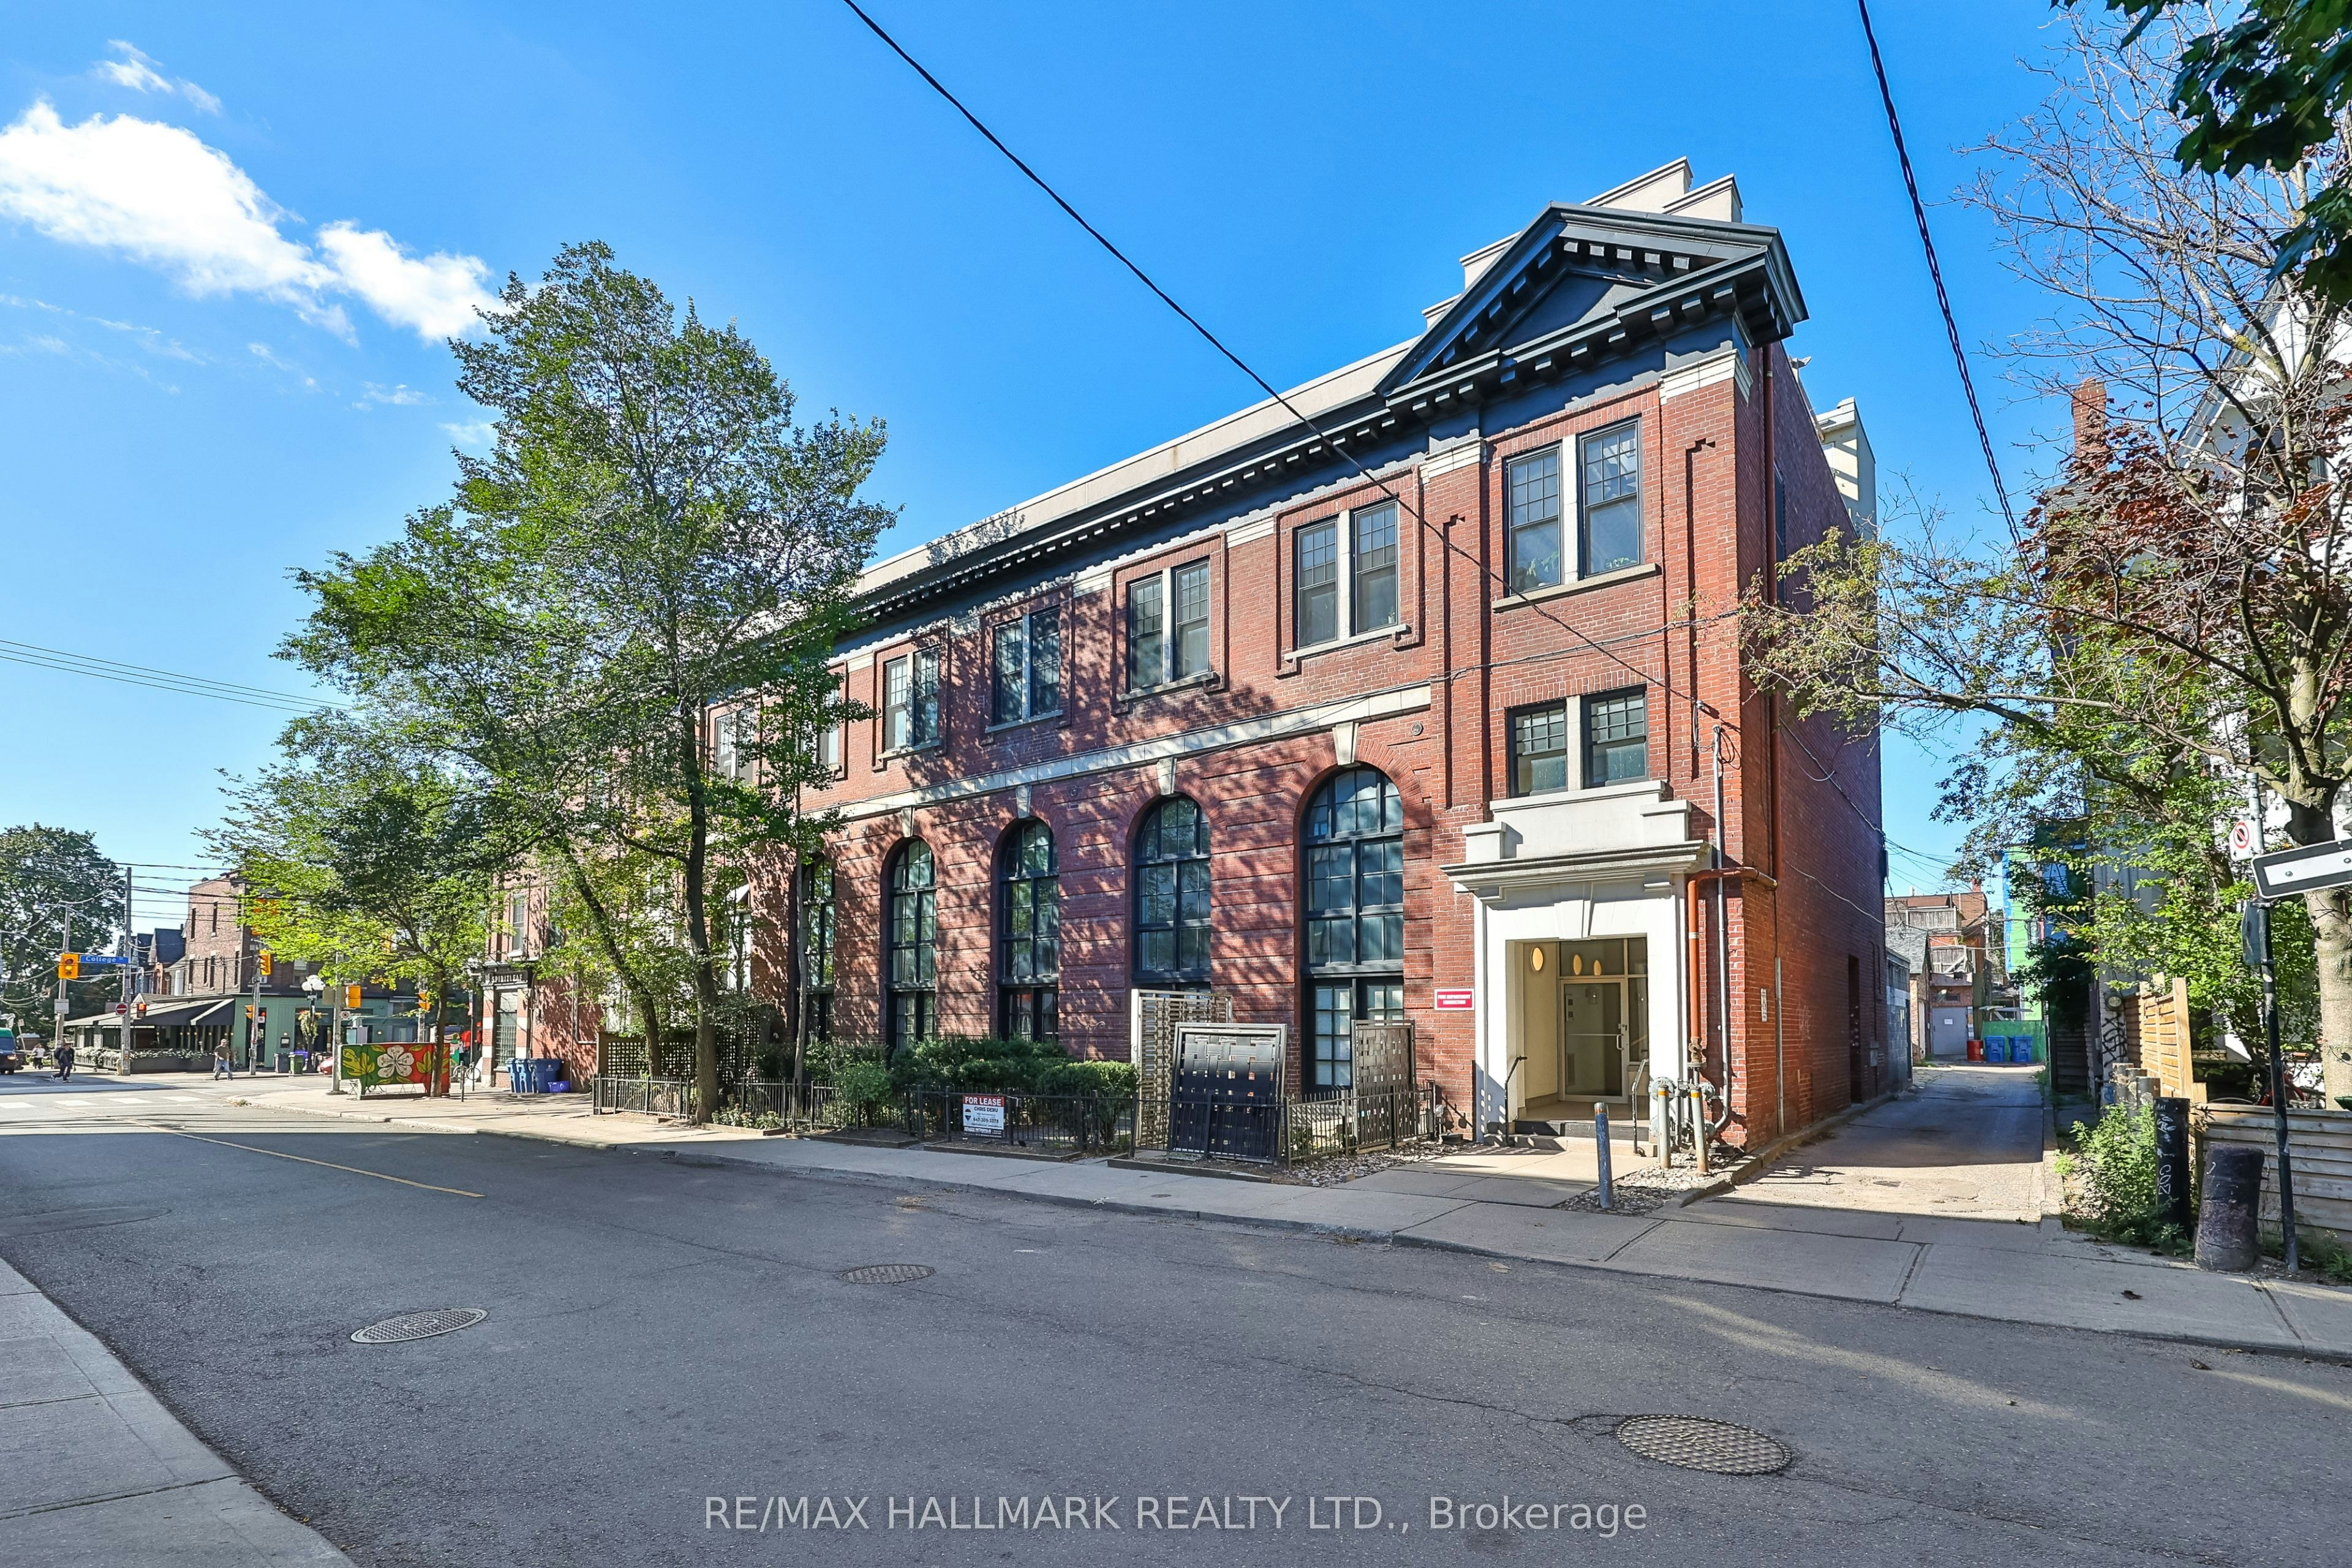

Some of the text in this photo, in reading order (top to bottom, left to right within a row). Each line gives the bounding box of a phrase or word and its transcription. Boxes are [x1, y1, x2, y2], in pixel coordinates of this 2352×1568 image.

[492, 974, 522, 983] SPIRITLEAF
[979, 1098, 1001, 1106] LEASE
[1663, 1427, 1740, 1459] DANGER
